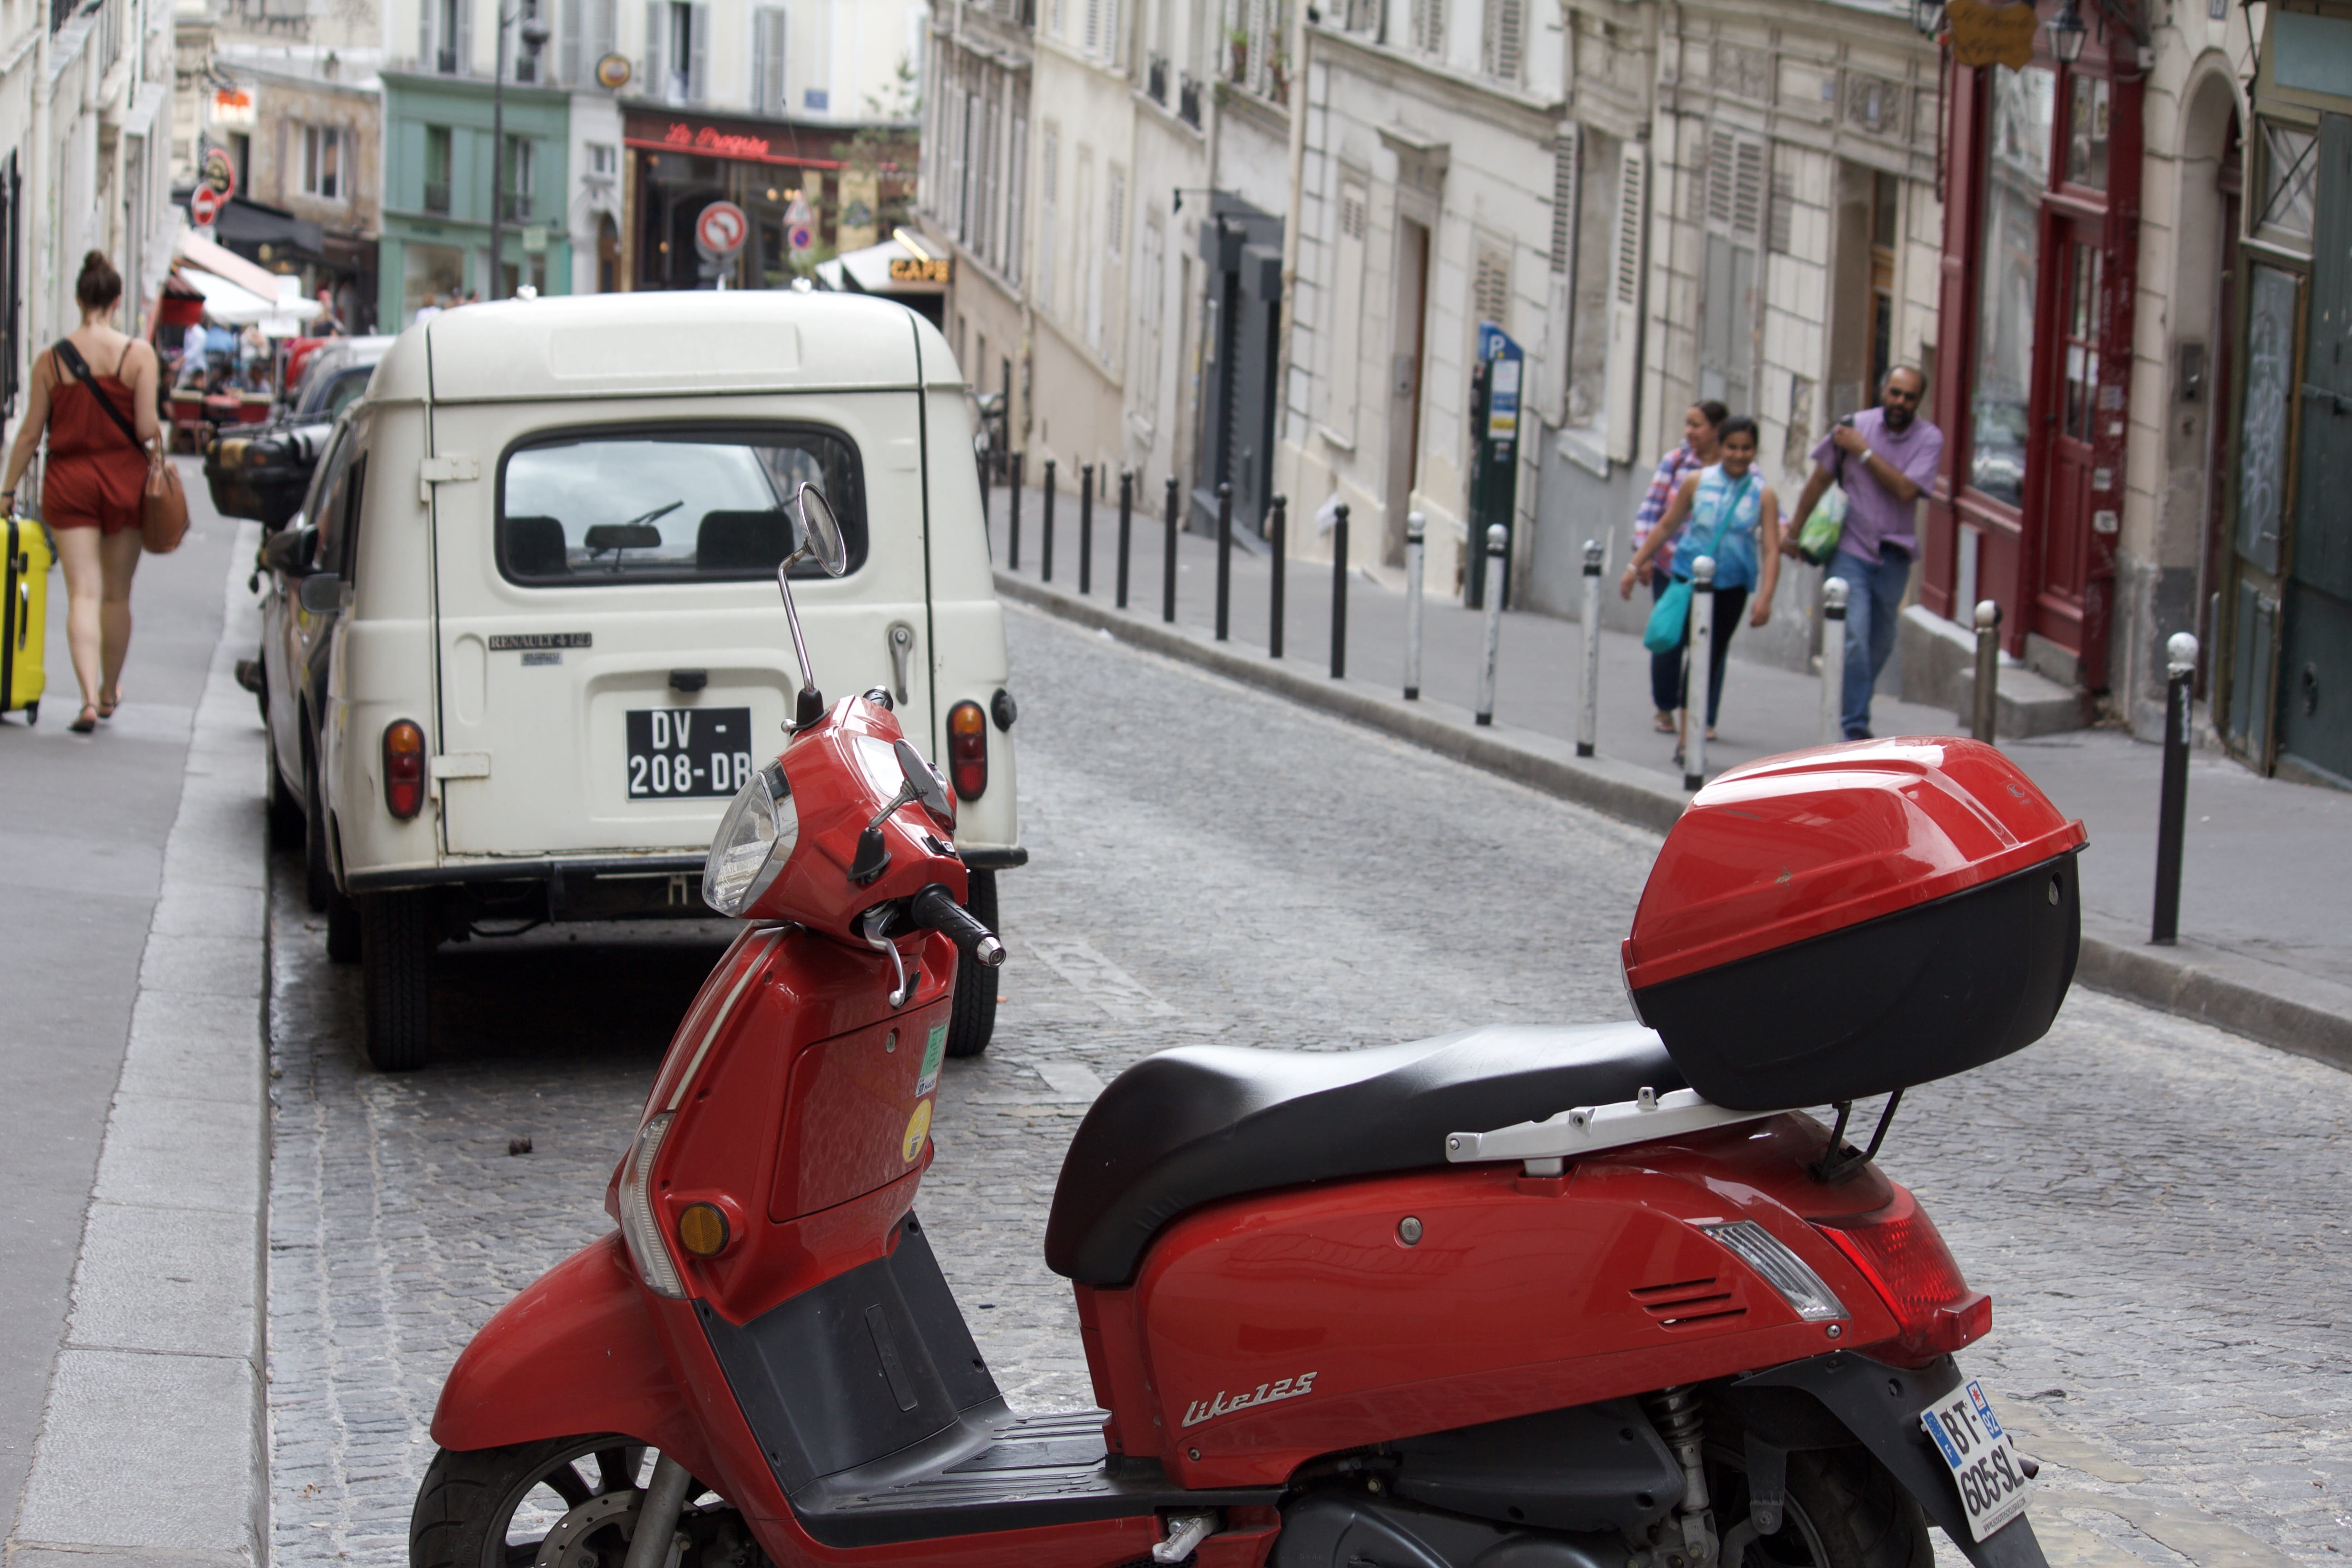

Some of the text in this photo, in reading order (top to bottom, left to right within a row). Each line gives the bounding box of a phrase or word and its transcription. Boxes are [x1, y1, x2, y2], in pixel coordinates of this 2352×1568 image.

[1489, 335, 1505, 358] P
[491, 635, 554, 648] RENAULT
[556, 634, 567, 646] 4
[652, 711, 691, 750] DV
[630, 751, 751, 794] 208-DR
[1982, 1410, 1999, 1435] 92
[1944, 1444, 1953, 1458] F
[1960, 1444, 2025, 1516] 605-SL
